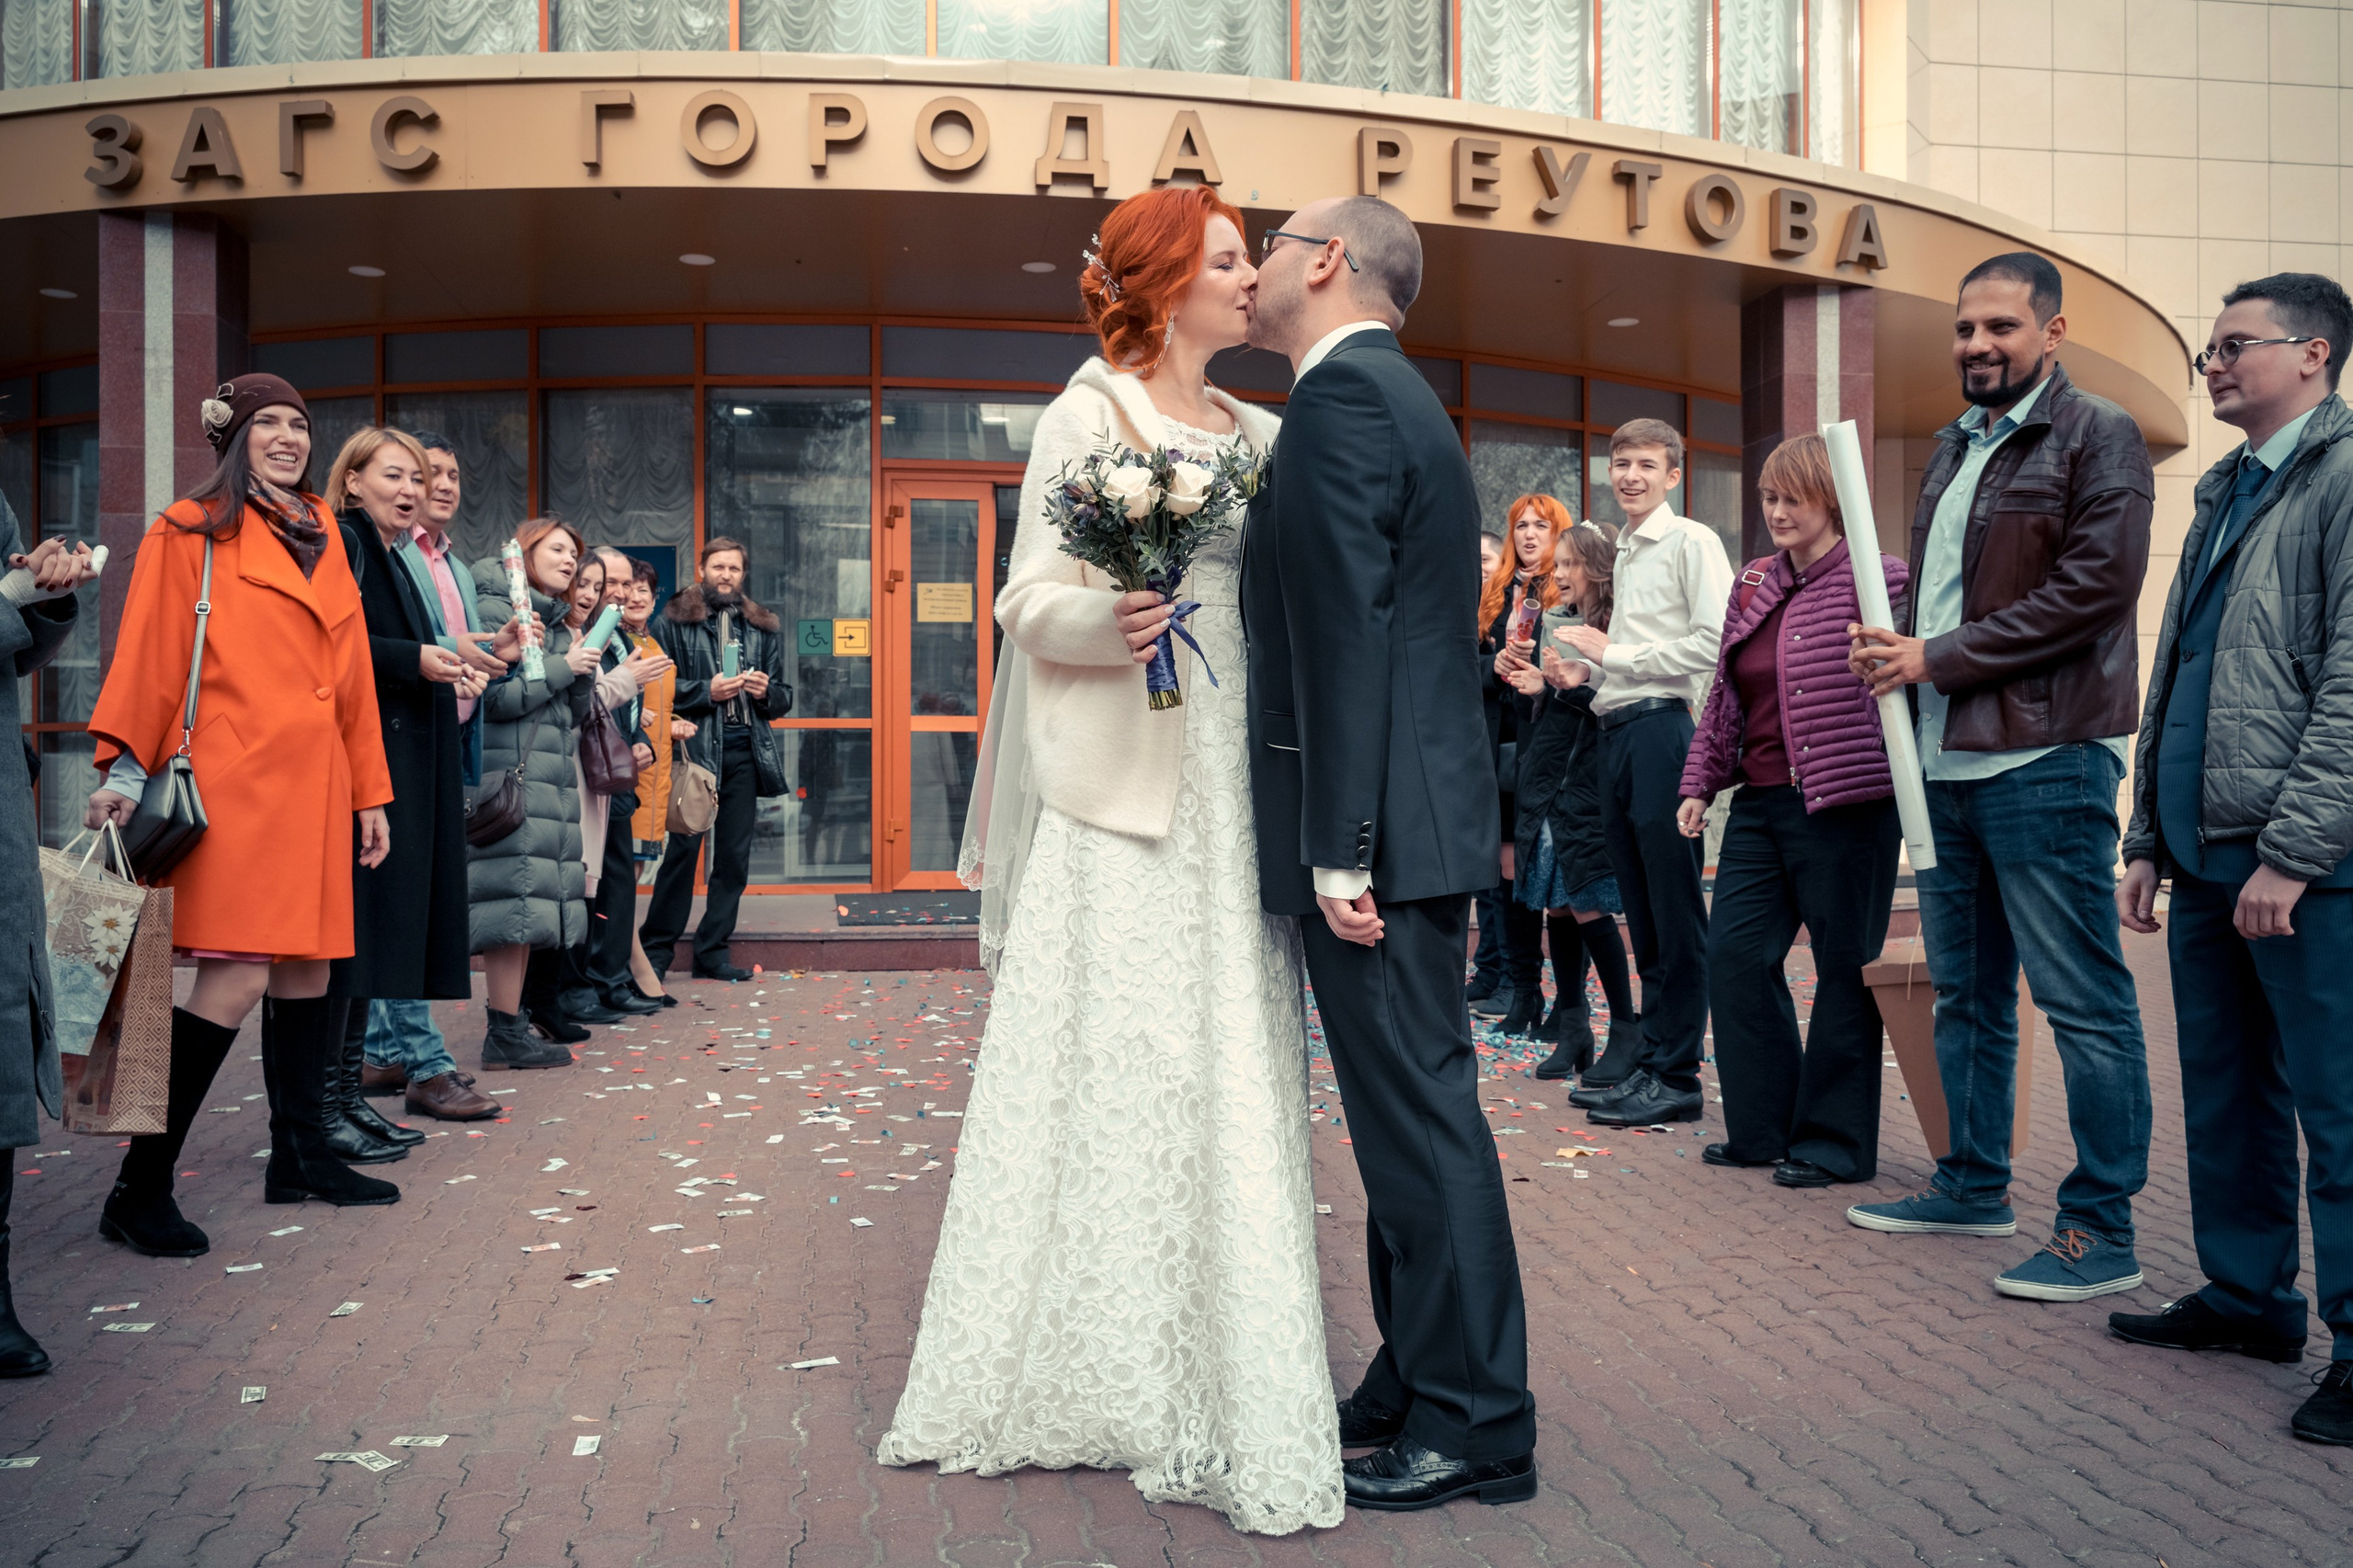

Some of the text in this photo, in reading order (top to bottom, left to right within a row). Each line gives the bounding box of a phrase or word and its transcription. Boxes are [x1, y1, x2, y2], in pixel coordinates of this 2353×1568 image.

[84, 89, 1888, 270] ЗАГС ГОРОДА РЕУТОВА
